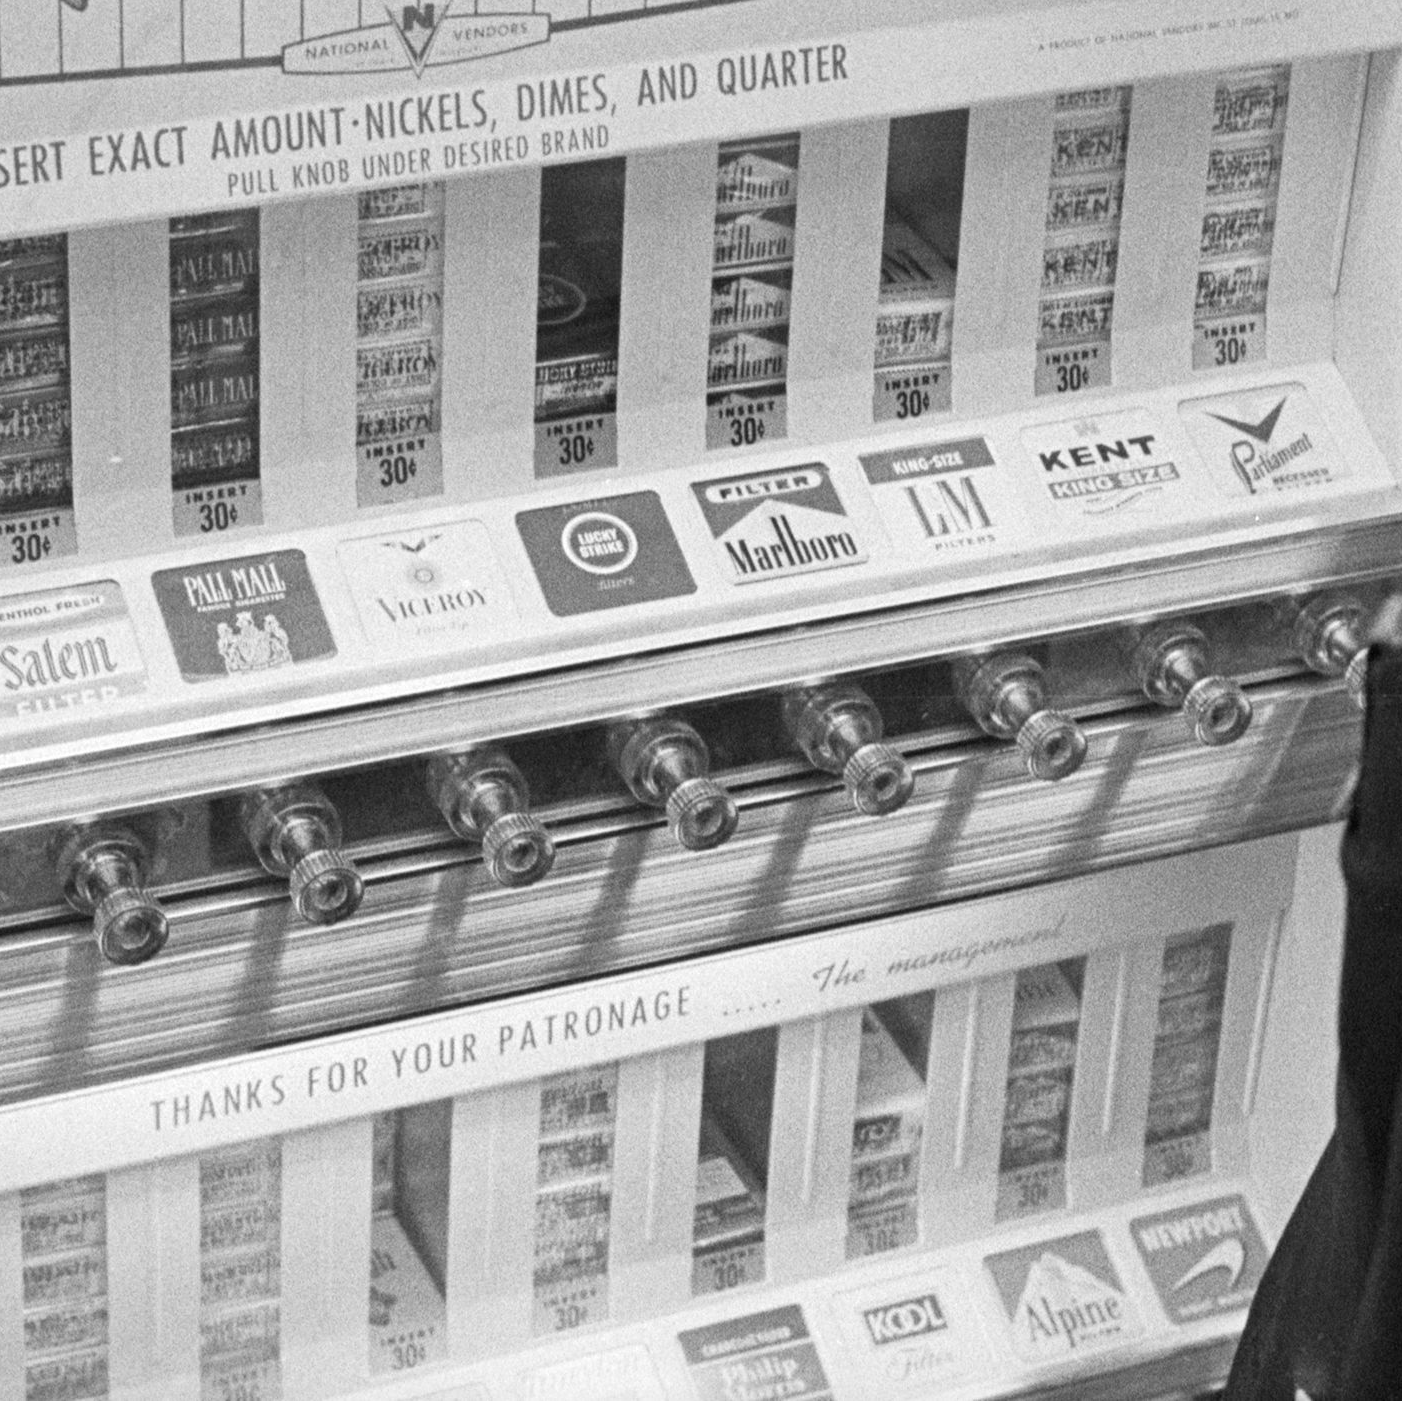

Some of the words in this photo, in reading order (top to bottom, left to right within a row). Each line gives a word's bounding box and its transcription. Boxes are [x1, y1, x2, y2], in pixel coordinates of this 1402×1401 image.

[304, 38, 390, 59] NATIONAL
[452, 21, 529, 42] VENDORS
[88, 126, 189, 176] EXACT
[515, 74, 617, 123] DIMES,
[636, 62, 699, 108] AND
[715, 42, 850, 97] QUARTER
[226, 169, 279, 198] PULL
[291, 159, 351, 191] KNOB
[361, 148, 432, 182] UNDER
[443, 134, 531, 170] DESIRED
[540, 123, 611, 157] BRAND
[221, 249, 258, 278] MAL
[220, 312, 258, 341] MAL
[1203, 322, 1256, 340] INSERT
[1045, 348, 1099, 366] INSERT
[1215, 337, 1247, 367] 30¢
[221, 375, 258, 403] MAL
[884, 374, 941, 392] INSERT
[1056, 363, 1090, 394] 30¢
[718, 400, 775, 419] INSERT
[896, 389, 931, 420] 30¢
[547, 417, 605, 437] INSERT
[729, 416, 766, 447] 30¢
[365, 438, 426, 460] INSERT
[558, 435, 595, 466] 30¢
[892, 450, 965, 476] KING-SIZE
[1038, 434, 1156, 473] KENT
[1229, 431, 1314, 496] Parliament
[378, 455, 417, 488] 30¢
[1053, 475, 1115, 499] KING
[1117, 463, 1178, 490] SIZE
[185, 484, 249, 505] INSERT
[718, 475, 811, 500] FILTER
[199, 501, 239, 533] 30¢
[11, 533, 52, 564] 30¢
[576, 527, 618, 546] LUCKY
[578, 538, 626, 559] STRIKE
[724, 513, 859, 576] Marlboro
[182, 570, 234, 607] PALL
[230, 561, 287, 598] MALL
[55, 595, 102, 612] FRESH
[377, 588, 487, 623] VICEROY
[17, 685, 119, 715] FILTER
[148, 1073, 290, 1134] THANKS
[306, 1059, 373, 1100] FOR
[390, 1033, 480, 1081] YOUR
[496, 985, 693, 1059] PATRONAGE
[812, 959, 867, 993] The
[887, 924, 1063, 976] management
[1140, 1206, 1243, 1251] NEWPORT
[868, 1297, 946, 1342] KOOL
[1026, 1295, 1122, 1349] Alpine
